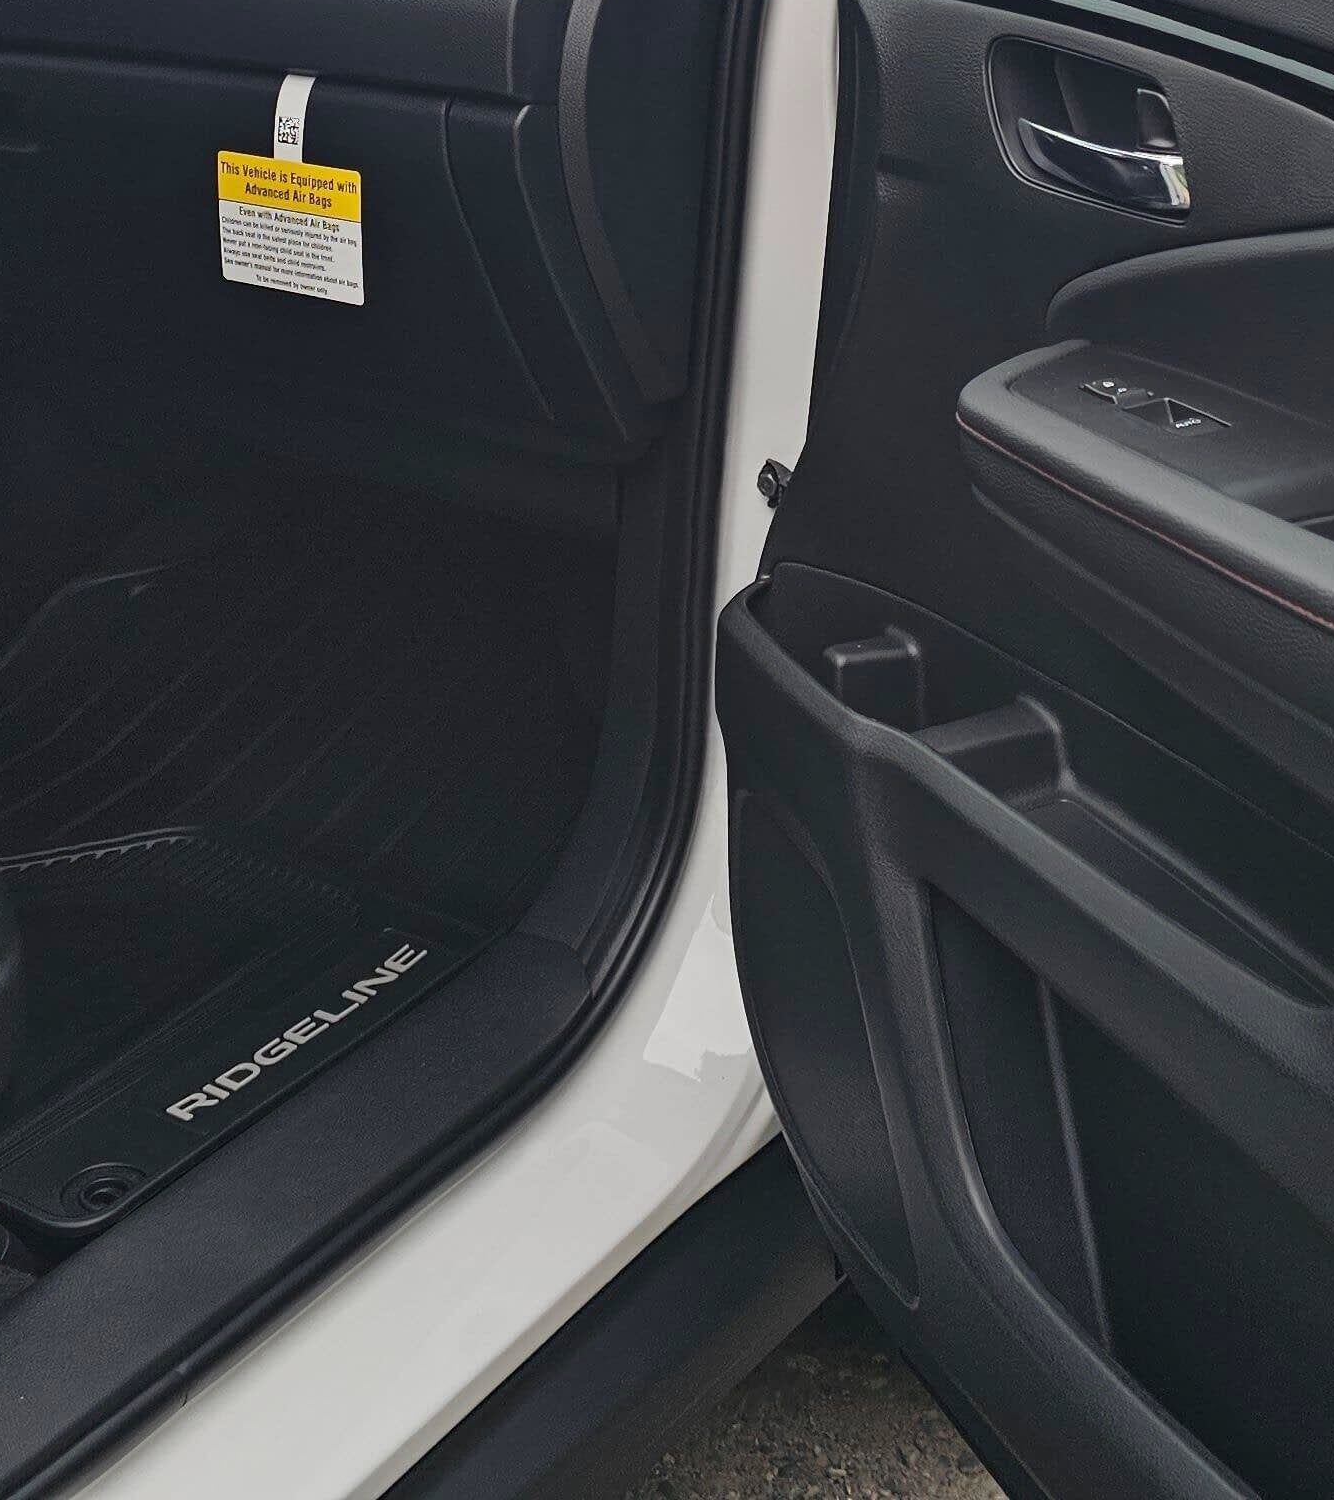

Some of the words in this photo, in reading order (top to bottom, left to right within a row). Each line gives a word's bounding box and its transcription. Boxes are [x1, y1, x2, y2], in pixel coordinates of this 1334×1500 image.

[221, 161, 239, 175] This
[243, 164, 276, 182] Vehicle
[279, 171, 287, 184] is
[291, 172, 334, 191] Equipped
[337, 182, 357, 194] with
[245, 182, 290, 200] Advanced
[293, 190, 306, 203] Air
[309, 192, 332, 209] Bags
[239, 206, 256, 218] Even
[257, 210, 272, 220] with
[274, 212, 308, 226] Advanced
[311, 218, 320, 228] Air
[323, 220, 339, 233] Bags
[166, 943, 428, 1121] RIDGELINE
